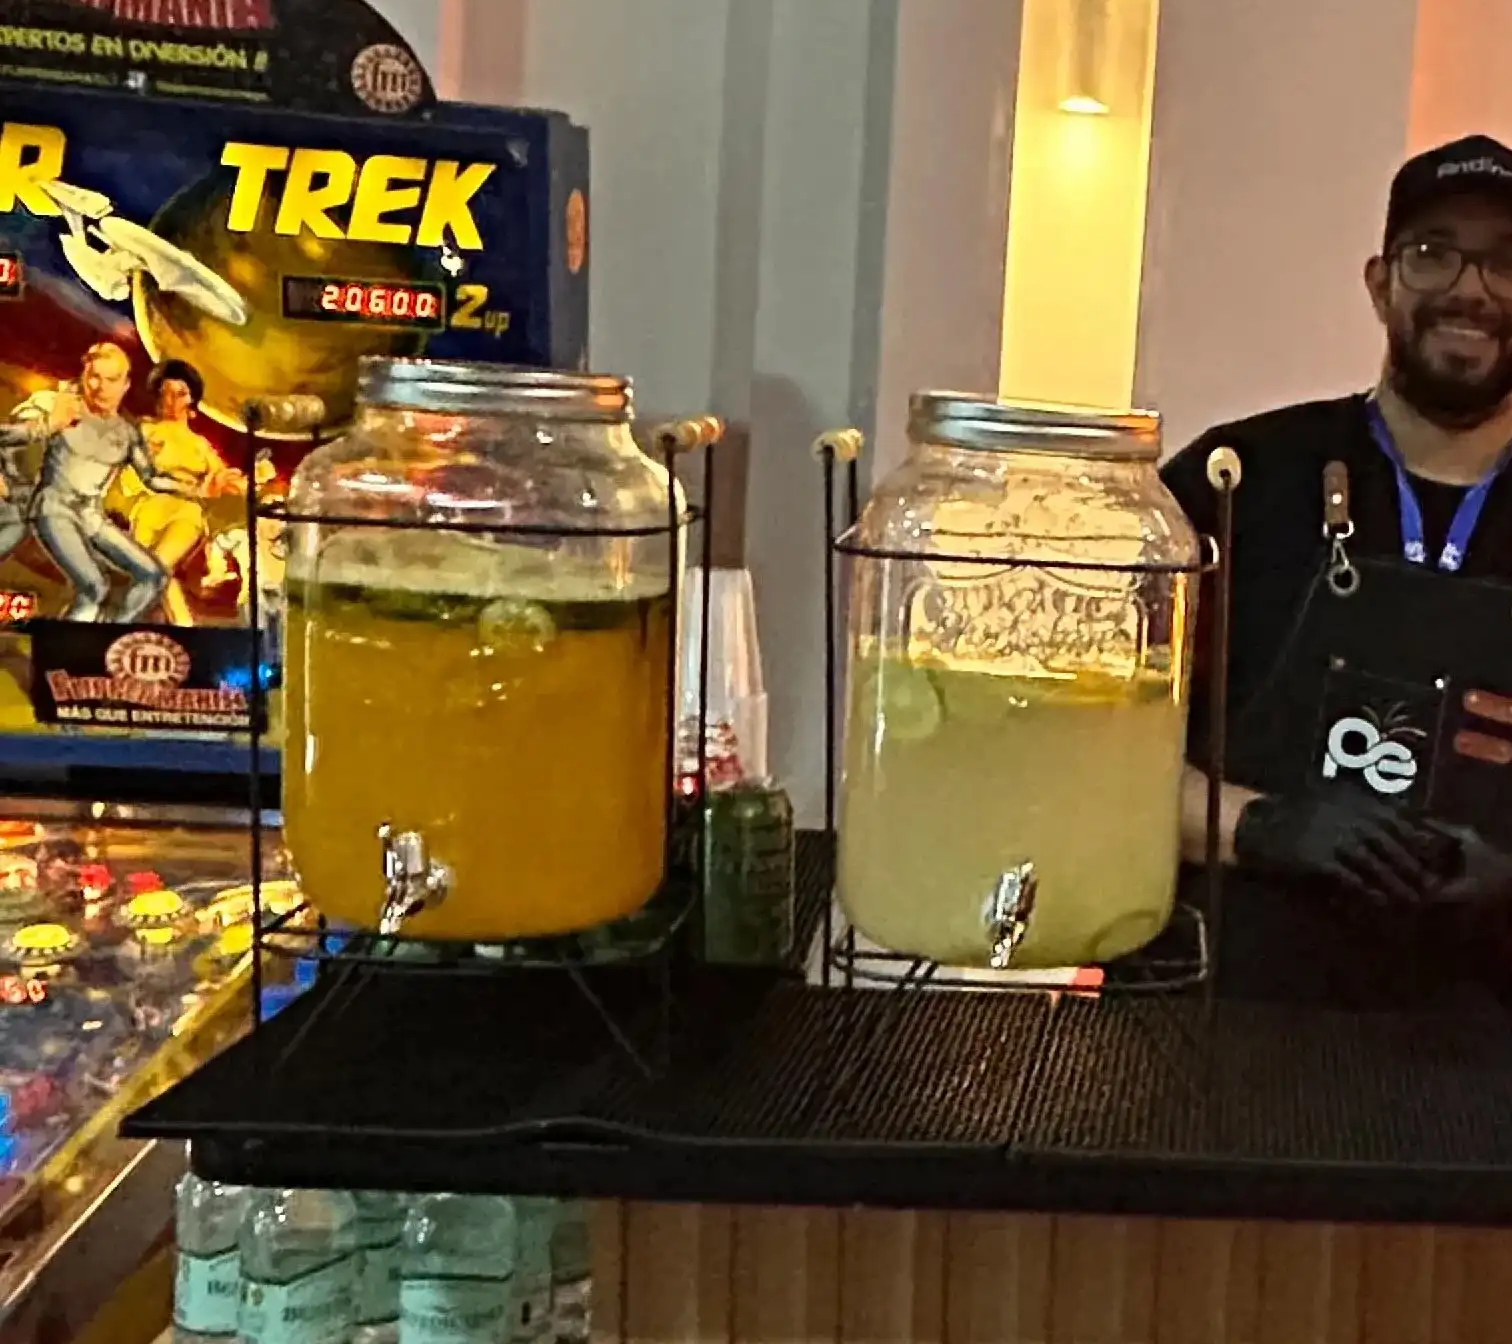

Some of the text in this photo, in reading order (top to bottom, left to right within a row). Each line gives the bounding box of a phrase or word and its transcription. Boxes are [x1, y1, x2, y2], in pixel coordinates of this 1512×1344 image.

[91, 34, 124, 57] EN
[220, 141, 497, 251] TREK
[321, 284, 434, 318] 20600
